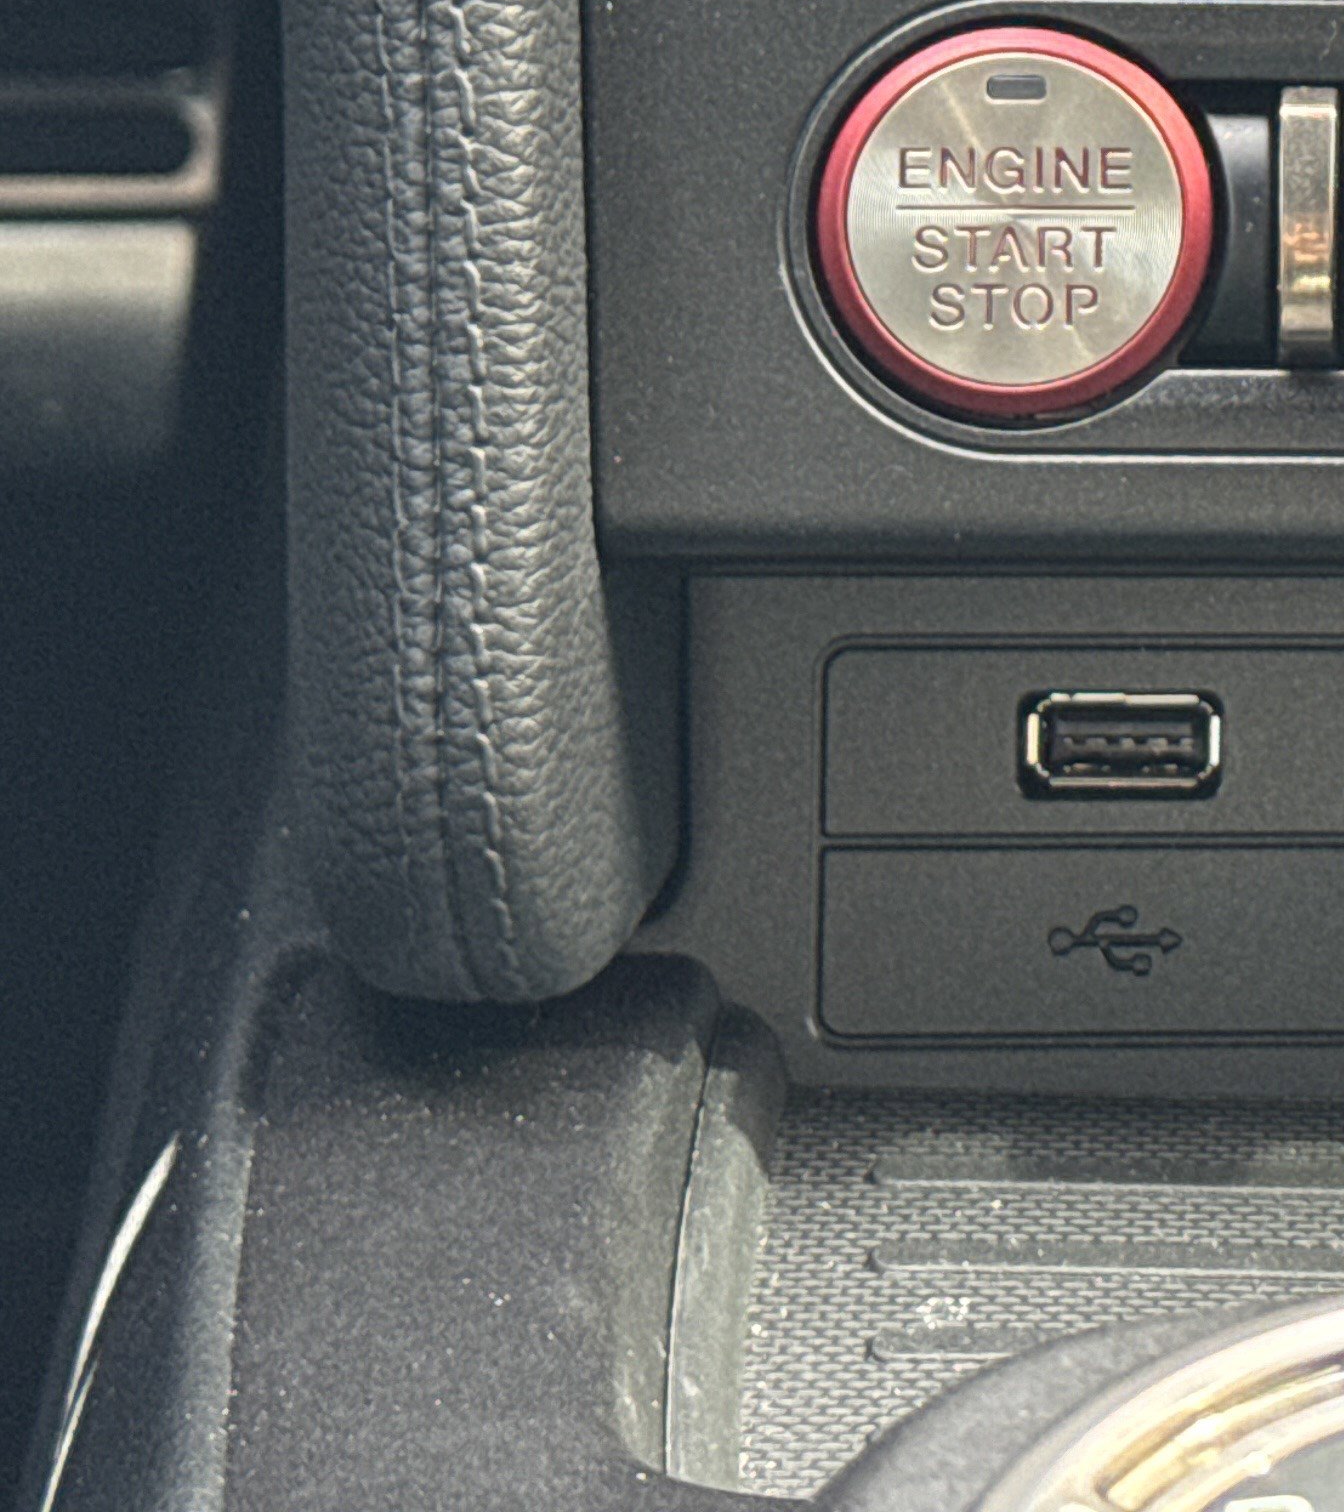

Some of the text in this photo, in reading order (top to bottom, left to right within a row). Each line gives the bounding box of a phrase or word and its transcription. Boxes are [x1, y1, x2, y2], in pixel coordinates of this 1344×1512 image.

[899, 146, 1134, 194] ENGINE
[911, 225, 1116, 273] START
[928, 283, 1098, 331] STOP
